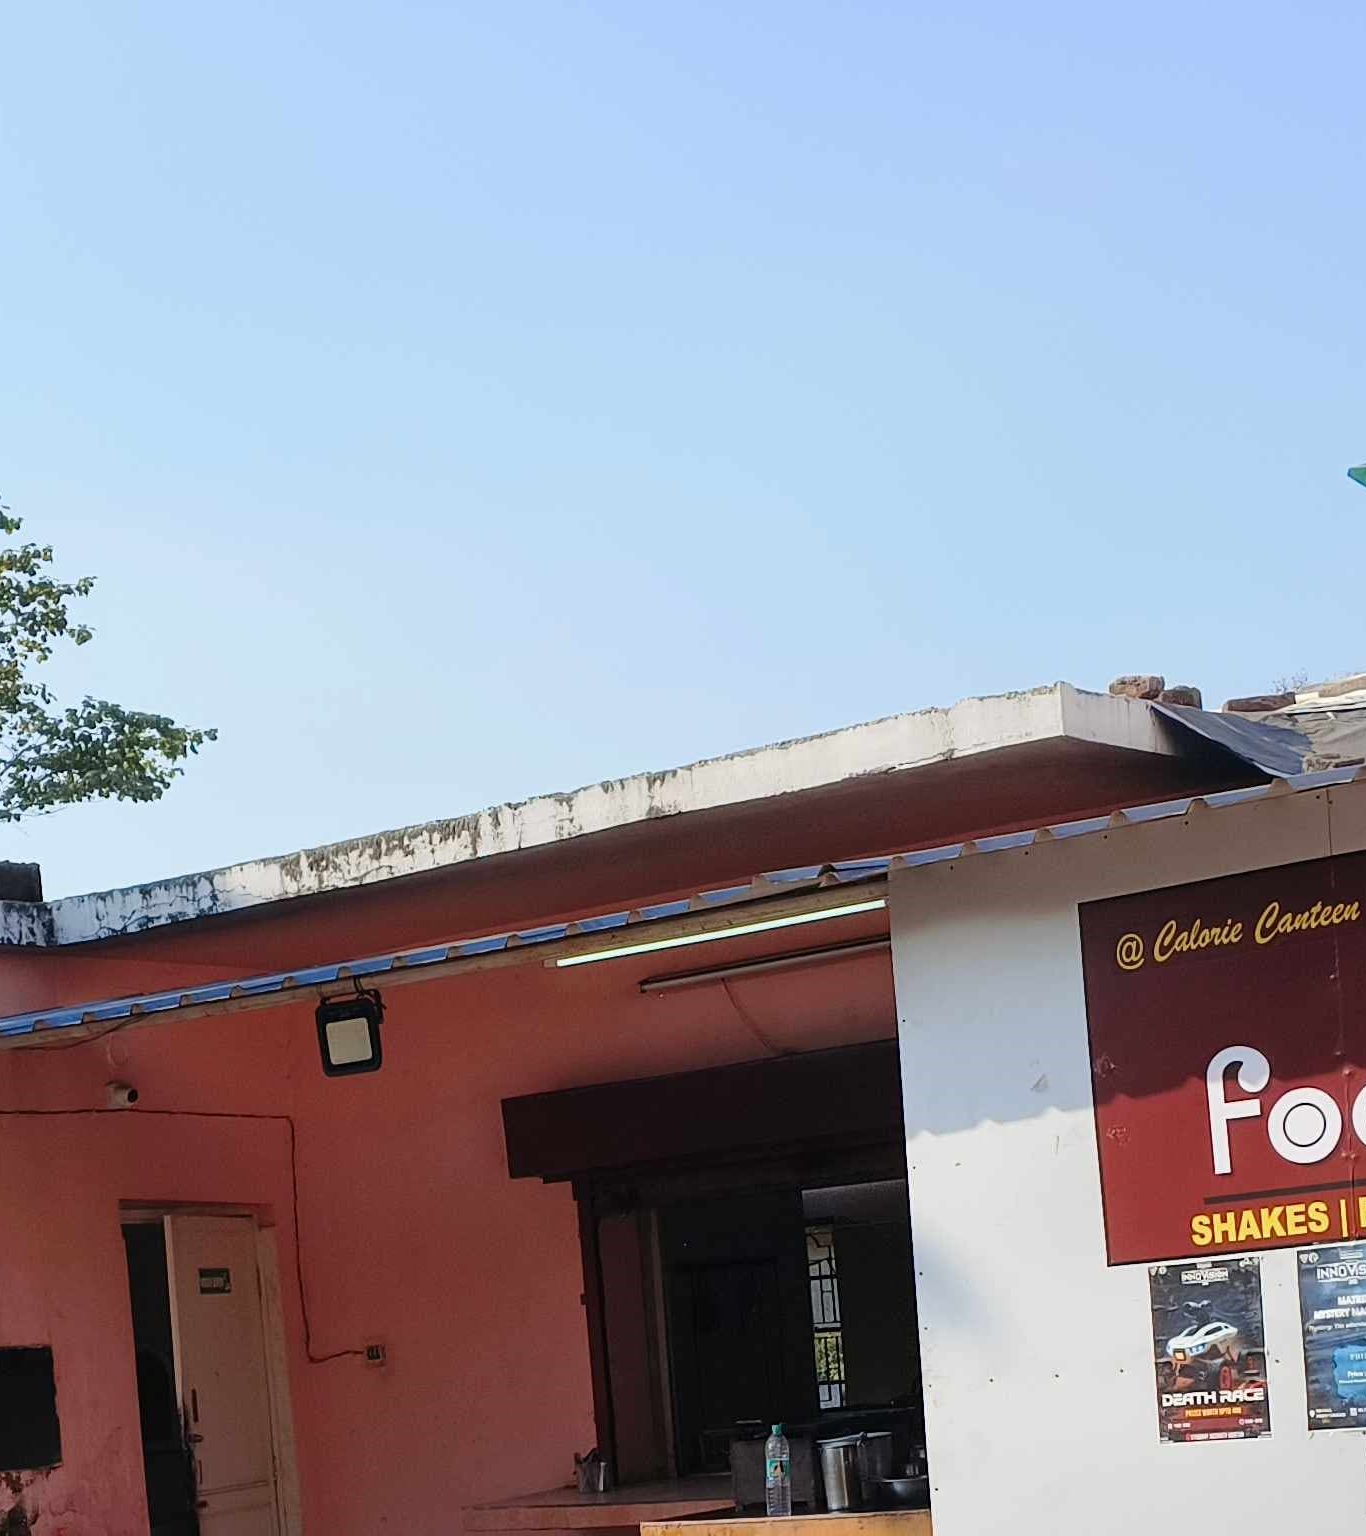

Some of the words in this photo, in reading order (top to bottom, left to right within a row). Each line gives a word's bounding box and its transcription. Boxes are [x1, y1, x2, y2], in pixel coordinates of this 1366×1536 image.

[1116, 933, 1145, 970] @
[1153, 918, 1243, 962] Calorie
[1254, 900, 1361, 944] Canteen
[1190, 1201, 1330, 1247] SHAKES
[1162, 1391, 1217, 1407] DEATH
[1220, 1387, 1265, 1403] RACE
